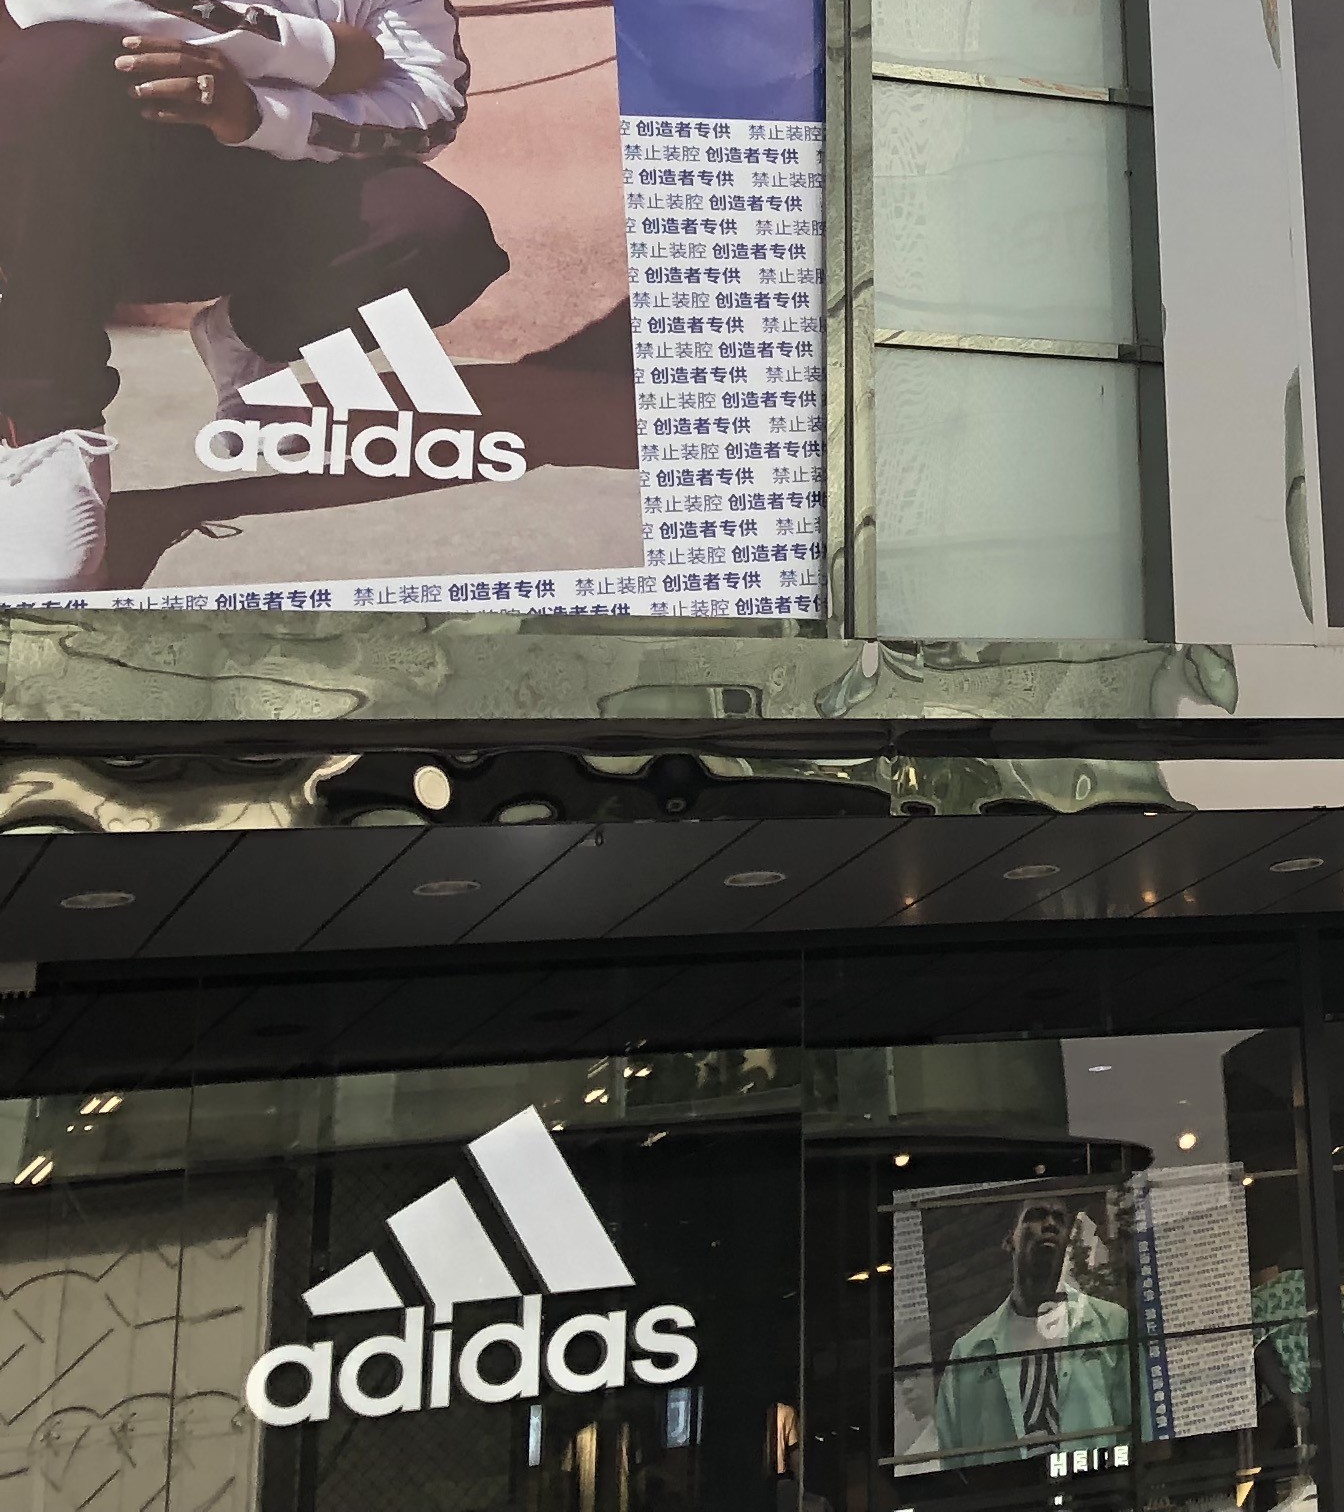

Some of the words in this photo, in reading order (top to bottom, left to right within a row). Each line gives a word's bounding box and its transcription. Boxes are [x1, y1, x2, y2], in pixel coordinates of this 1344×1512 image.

[636, 120, 731, 139] 创造者专供
[705, 146, 799, 164] 创造者专供
[639, 168, 734, 187] 创造者专供
[709, 194, 802, 212] 创造者专供
[641, 217, 738, 236] 创造者专供
[712, 243, 807, 261] 创造者专供
[645, 267, 741, 285] 创造者专供
[715, 291, 810, 309] 创造者专供
[647, 316, 744, 334] 创造者专供
[718, 341, 814, 359] 创造者专供
[650, 366, 747, 384] 创造者专供
[722, 391, 817, 409] 创造者专供
[653, 417, 751, 435] 创造者专供
[195, 406, 527, 482] adidas
[725, 440, 821, 460] 创造者专供
[656, 467, 754, 487] 创造者专供
[728, 491, 821, 511] 创造者专供
[659, 519, 757, 539] 创造者专供
[448, 580, 555, 602] 创造者专供
[663, 571, 762, 593] 创造者专供
[245, 1293, 698, 1427] adidas
